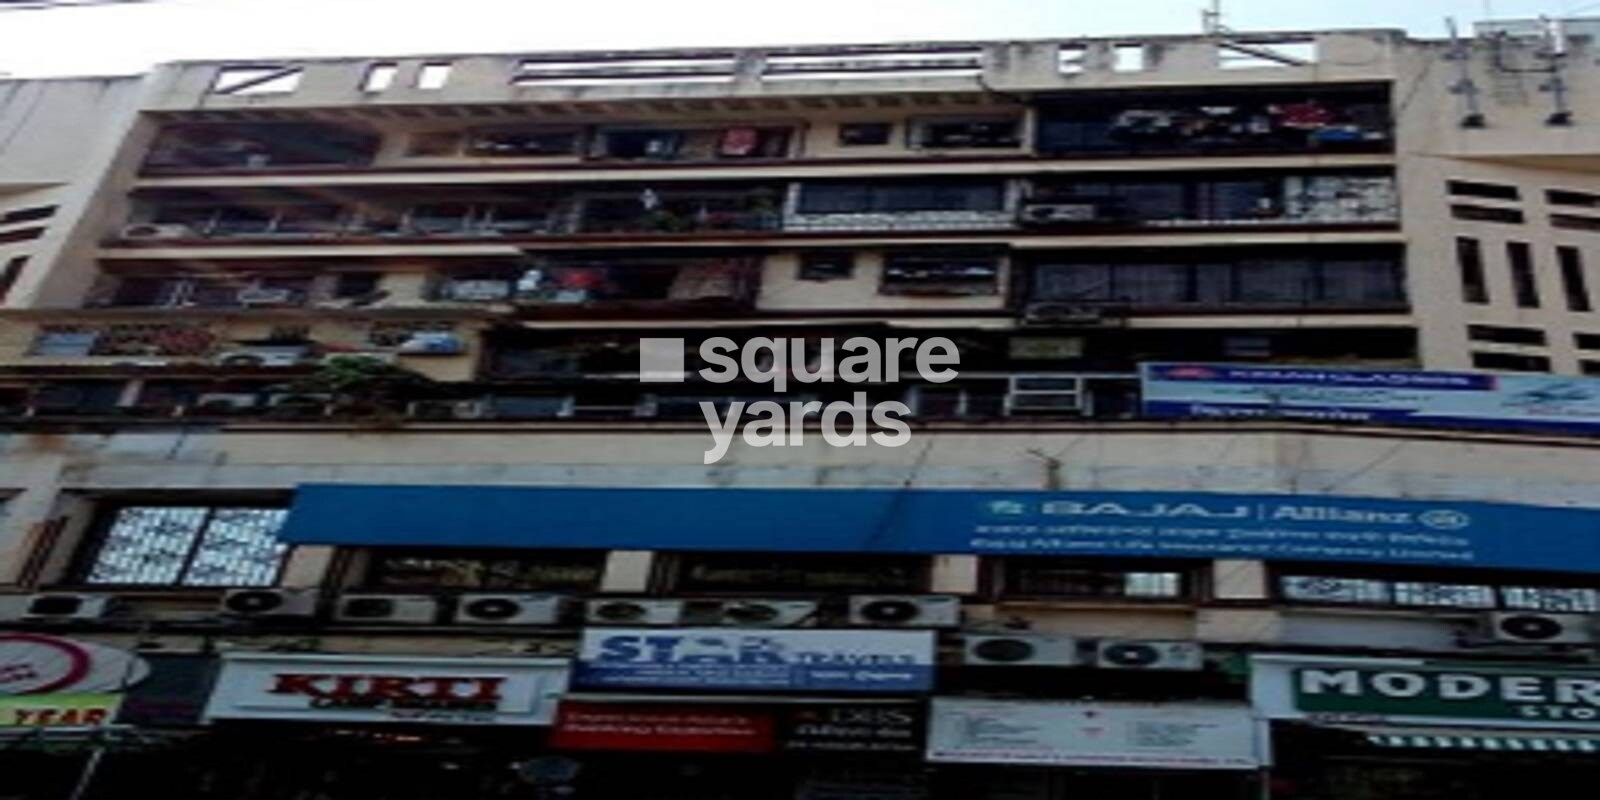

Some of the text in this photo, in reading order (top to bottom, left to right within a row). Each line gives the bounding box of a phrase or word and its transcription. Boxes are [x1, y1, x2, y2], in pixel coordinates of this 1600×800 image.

[1041, 499, 1412, 526] BAJAJ Allianz
[596, 635, 786, 665] STAR
[265, 673, 509, 701] KIRTI
[15, 708, 107, 727] YEAR
